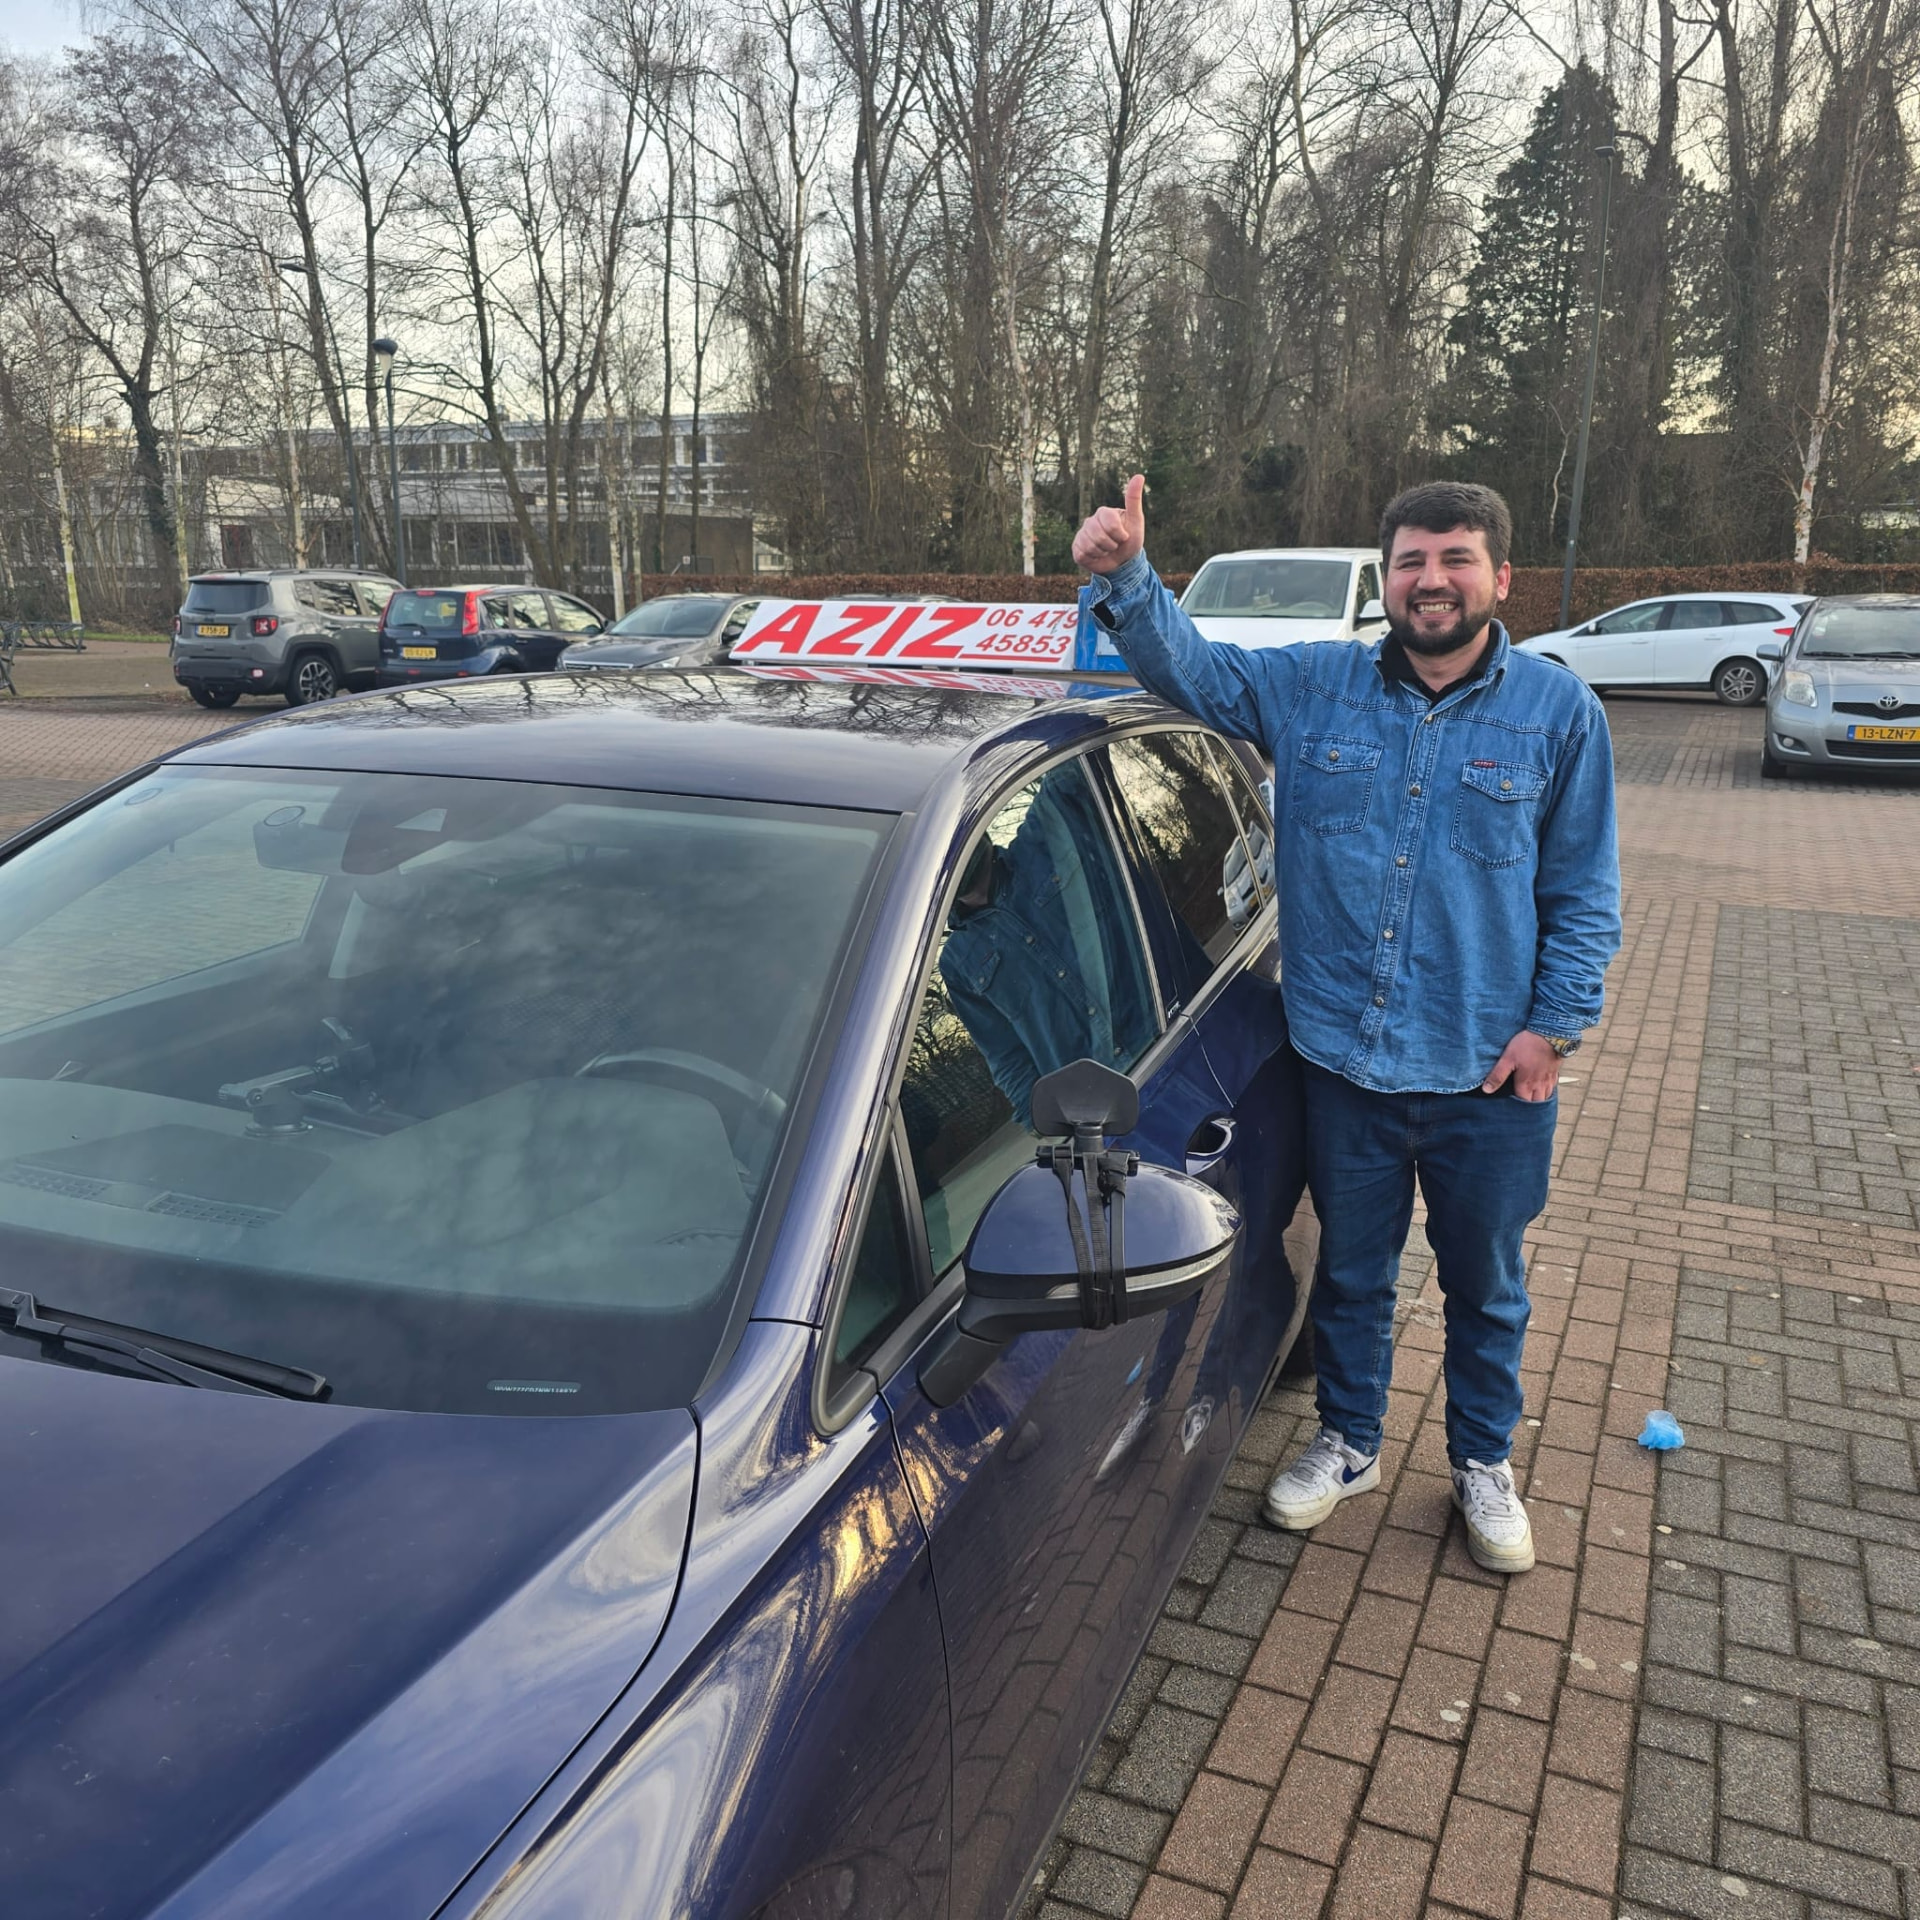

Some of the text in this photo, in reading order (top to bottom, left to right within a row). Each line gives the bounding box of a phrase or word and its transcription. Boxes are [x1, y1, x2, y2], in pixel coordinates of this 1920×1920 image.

[986, 608, 1079, 629] 06 479
[734, 604, 988, 659] AZIZ
[975, 633, 1072, 655] 45853
[1862, 728, 1917, 740] 13-LZN-7
